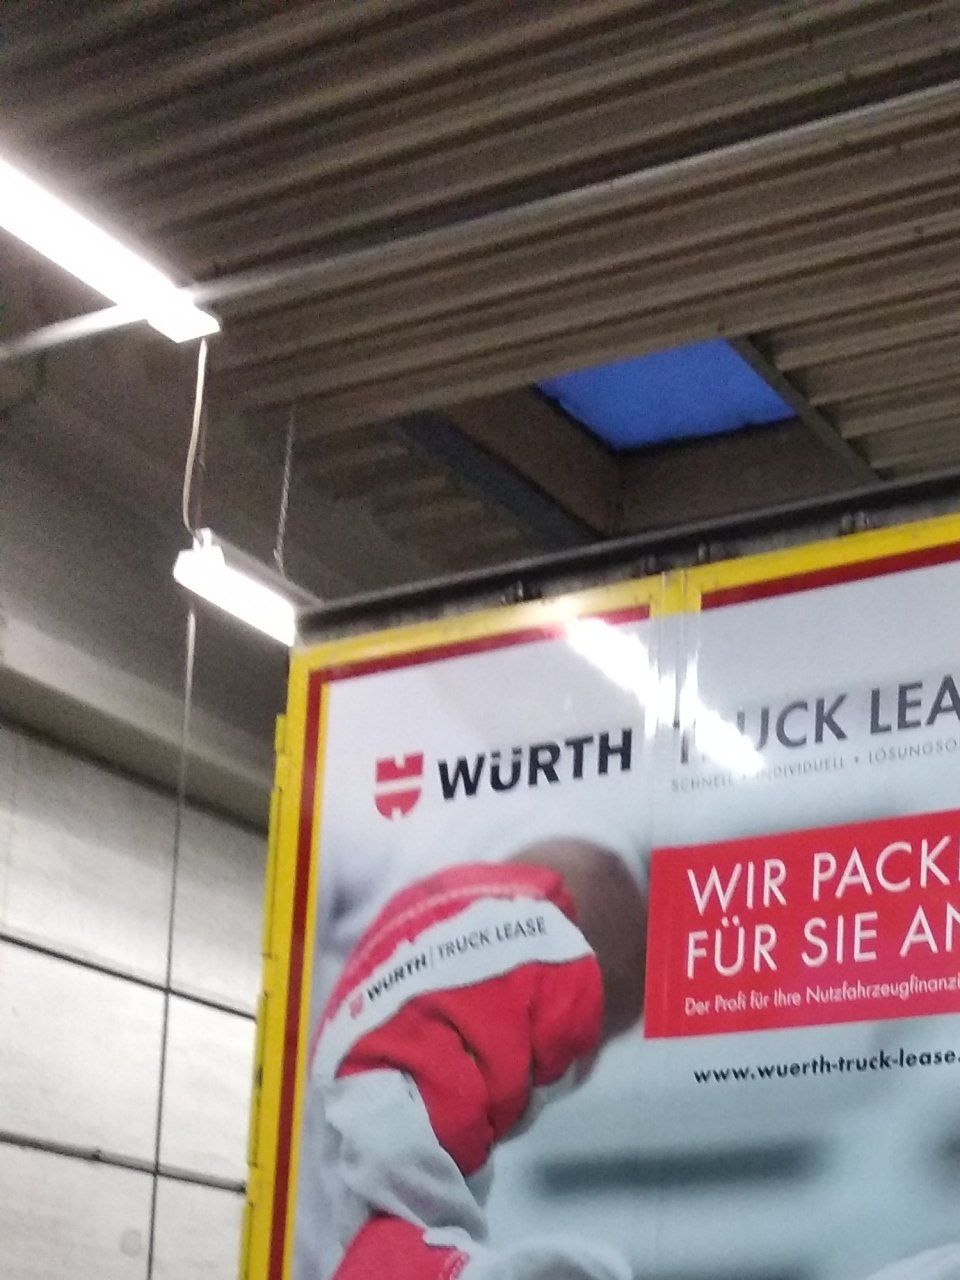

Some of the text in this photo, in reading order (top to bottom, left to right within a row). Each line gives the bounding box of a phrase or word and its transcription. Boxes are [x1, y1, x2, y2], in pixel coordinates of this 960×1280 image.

[437, 727, 633, 801] WÜRTH
[686, 857, 787, 916] WIR
[437, 928, 492, 960] TRUCK
[495, 915, 548, 942] LEASE
[686, 914, 777, 980] FÜR
[801, 911, 879, 968] SIE
[684, 996, 709, 1017] Der
[715, 990, 746, 1012] Profi
[749, 989, 770, 1010] für
[773, 987, 801, 1008] Ihre
